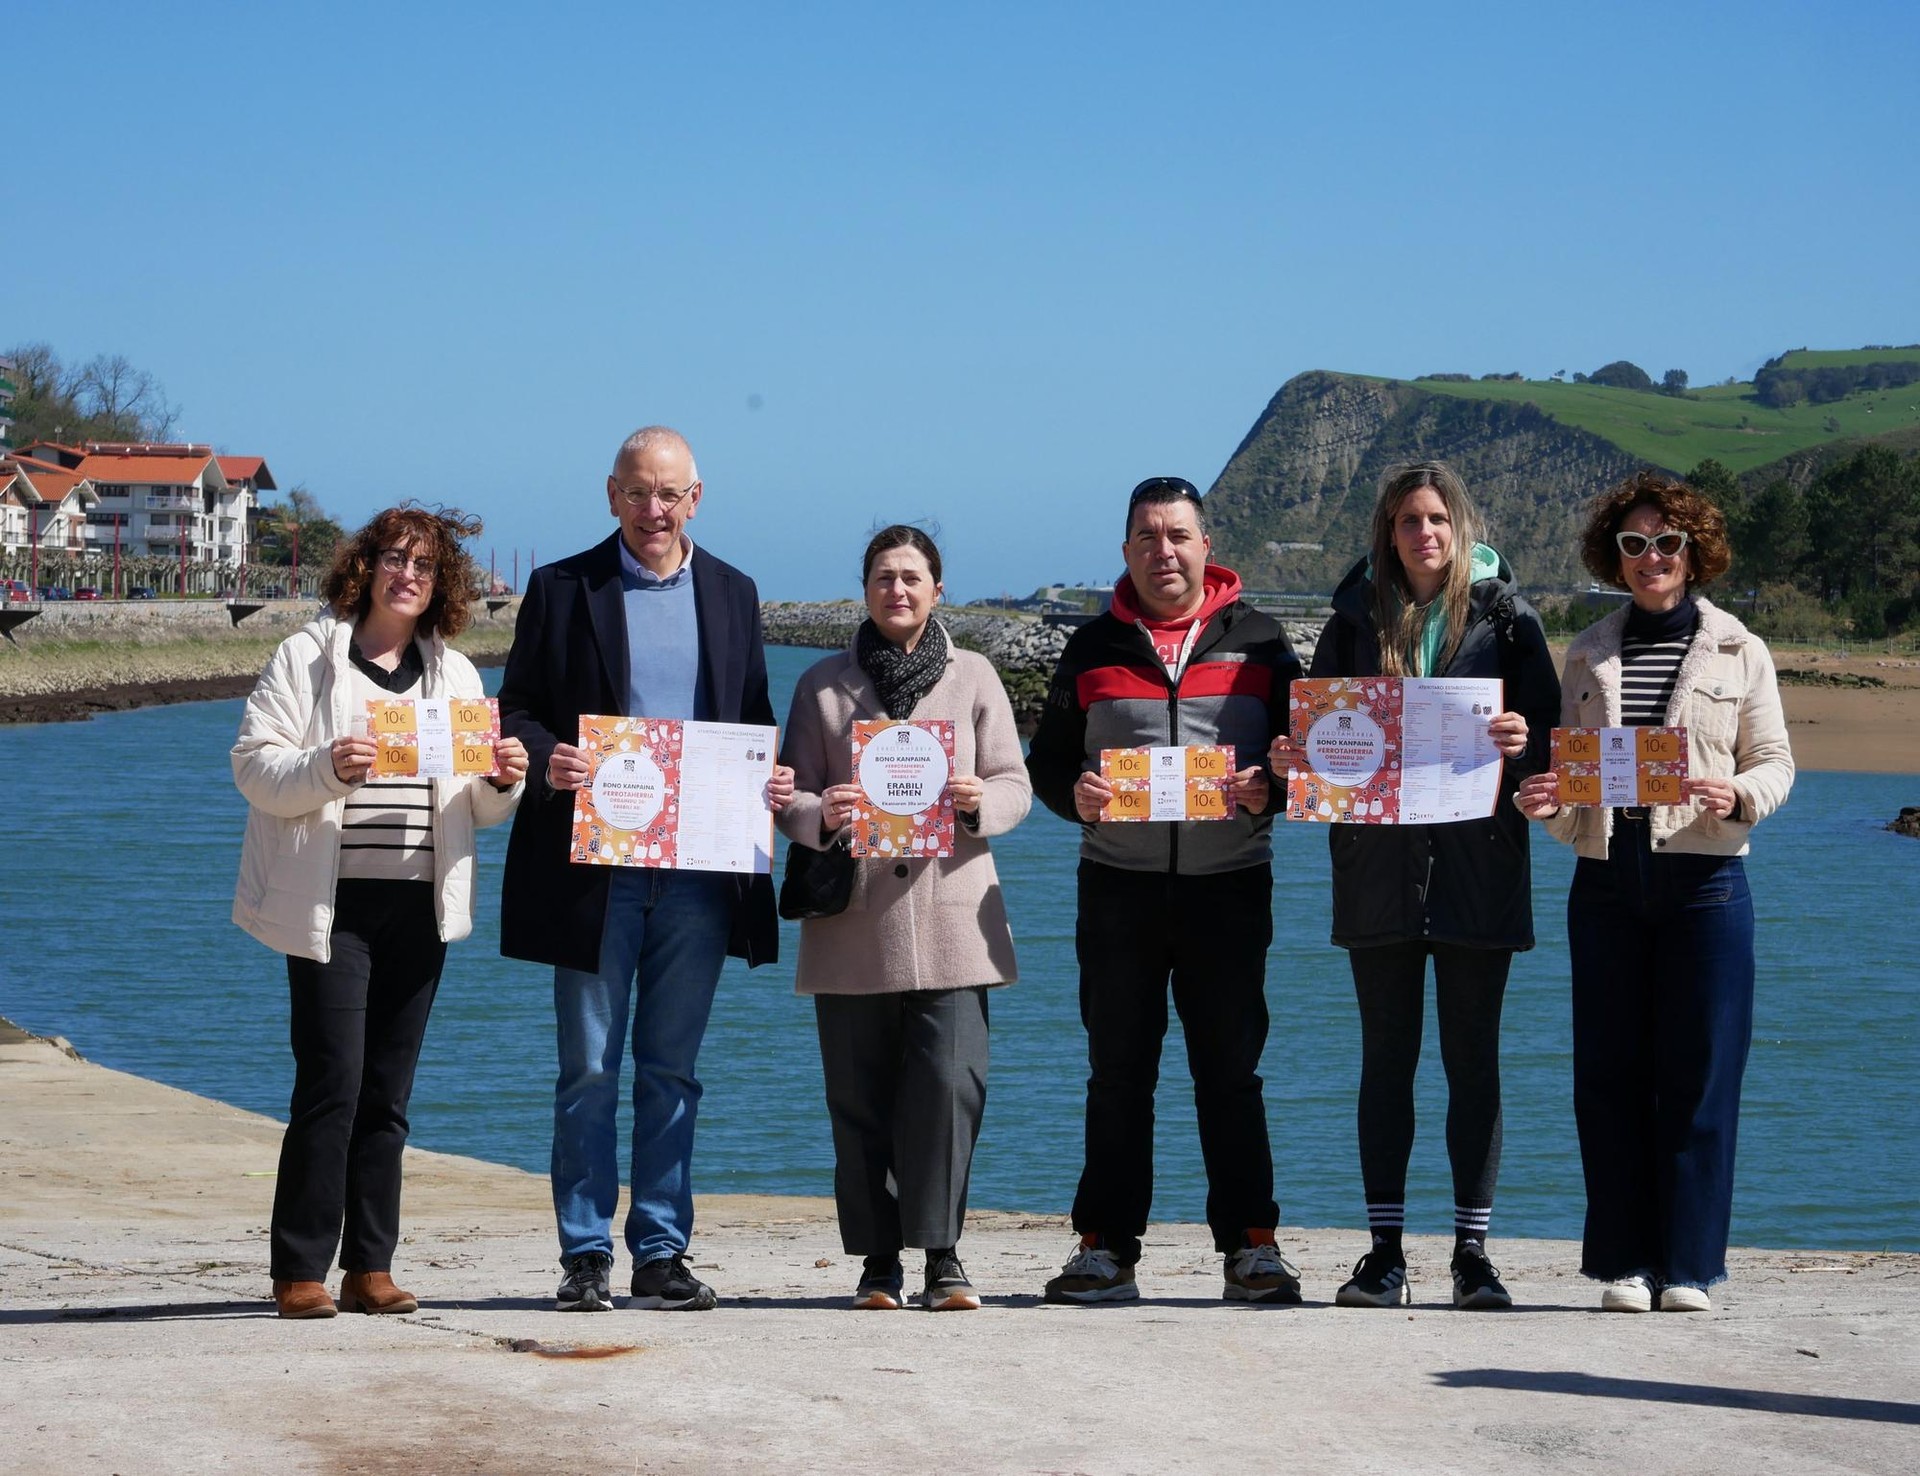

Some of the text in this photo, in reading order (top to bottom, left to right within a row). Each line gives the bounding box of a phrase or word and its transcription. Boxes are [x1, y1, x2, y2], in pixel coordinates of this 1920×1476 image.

[384, 711, 406, 724] 10€
[459, 710, 481, 723] 10€
[1317, 747, 1374, 755] #ERROTAHERRIA
[1568, 740, 1590, 753] 10€
[1644, 739, 1668, 752] 10€
[386, 750, 408, 763] 10€
[461, 749, 482, 762] 10€
[1118, 759, 1140, 771] 10€
[1193, 757, 1215, 769] 10€
[623, 783, 655, 791] KANPAINA
[887, 782, 923, 790] ERABILI
[1568, 780, 1590, 793] 10€
[1646, 779, 1669, 793] 10€
[602, 790, 654, 799] #ERROTAHERRIA
[1118, 795, 1140, 807] 10€
[1193, 794, 1216, 807] 10€
